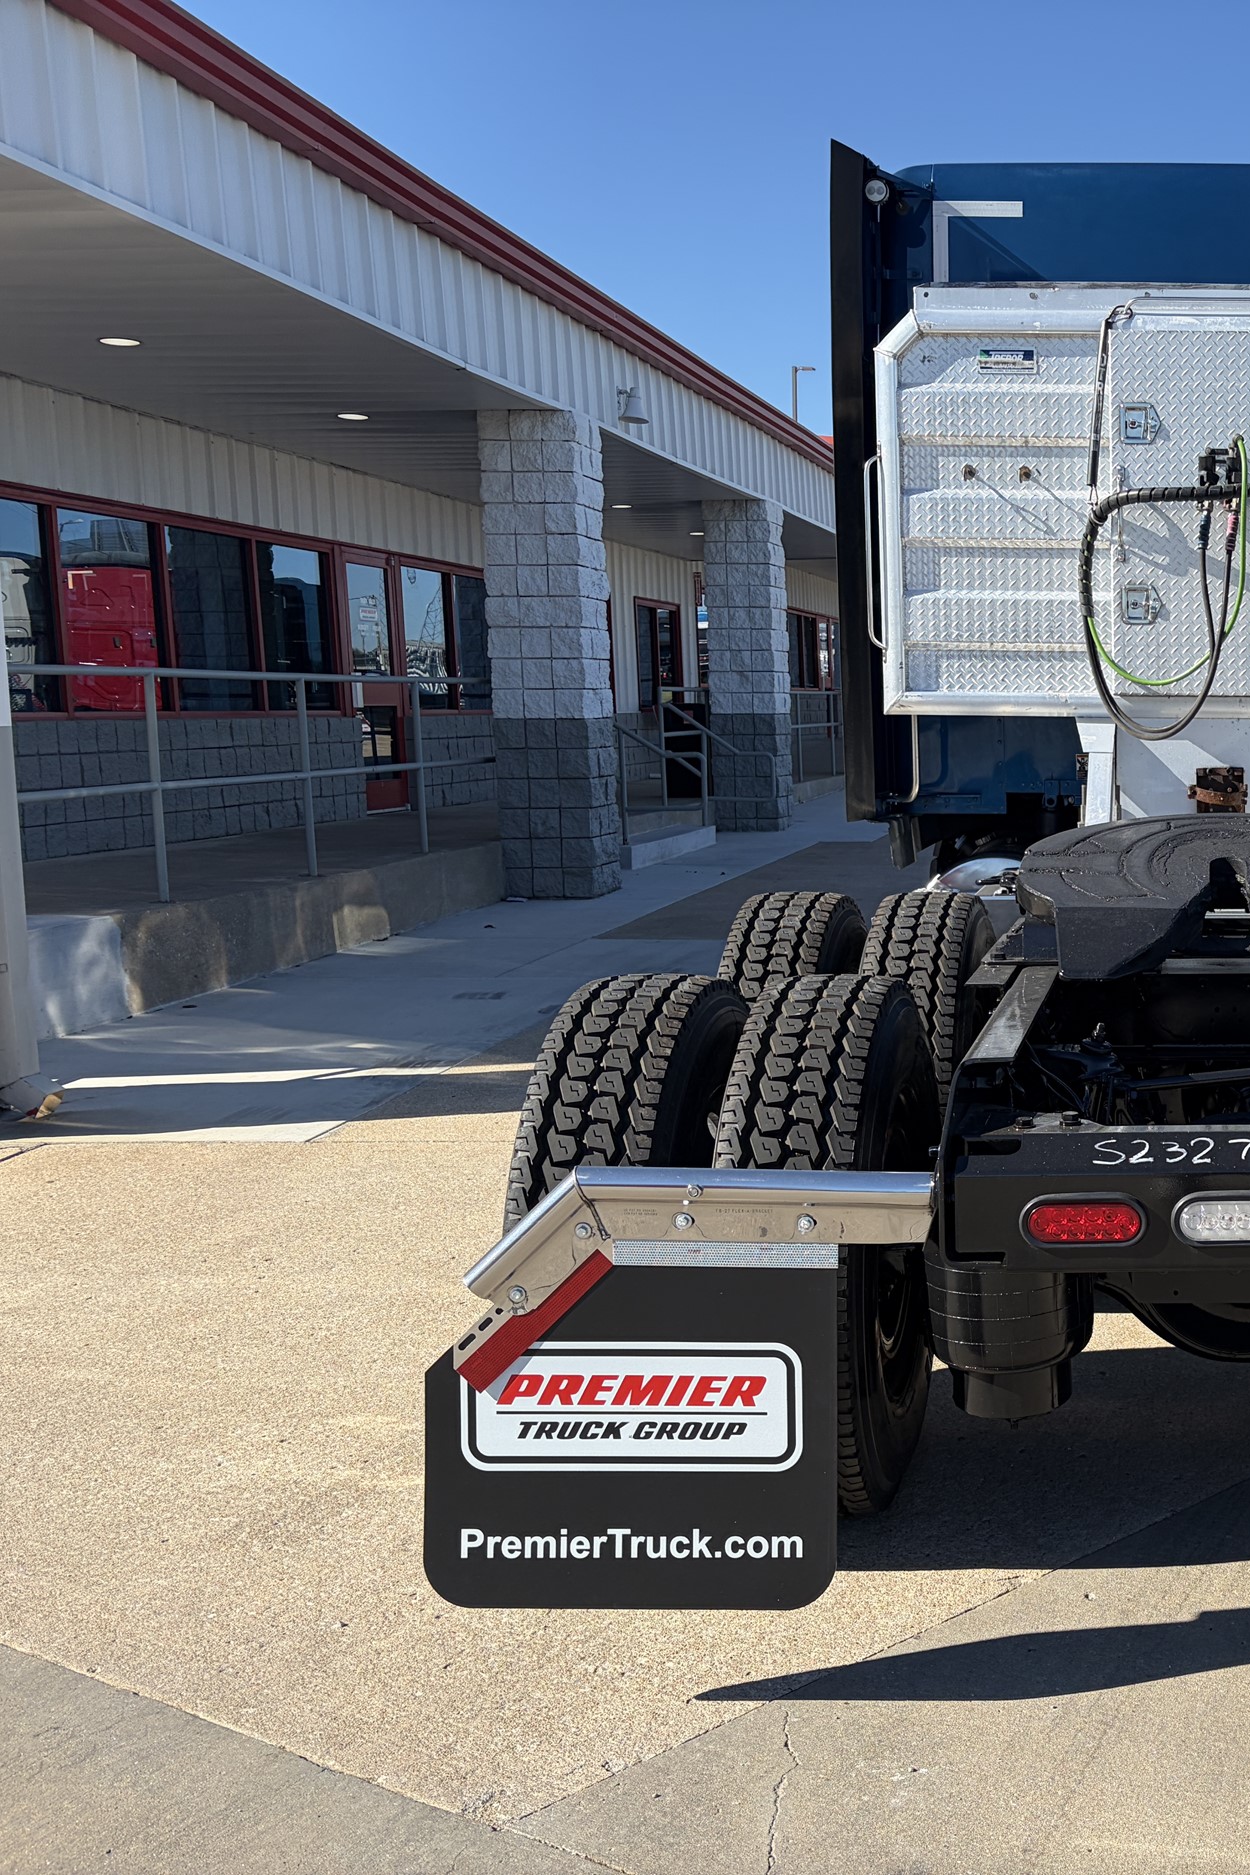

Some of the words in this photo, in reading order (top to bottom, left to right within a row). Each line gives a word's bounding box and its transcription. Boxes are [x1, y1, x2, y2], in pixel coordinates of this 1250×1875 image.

[496, 1373, 768, 1408] PREMIER
[516, 1421, 630, 1440] TRUCK
[631, 1421, 748, 1441] GROUP
[459, 1527, 804, 1560] PremierTruck.com
